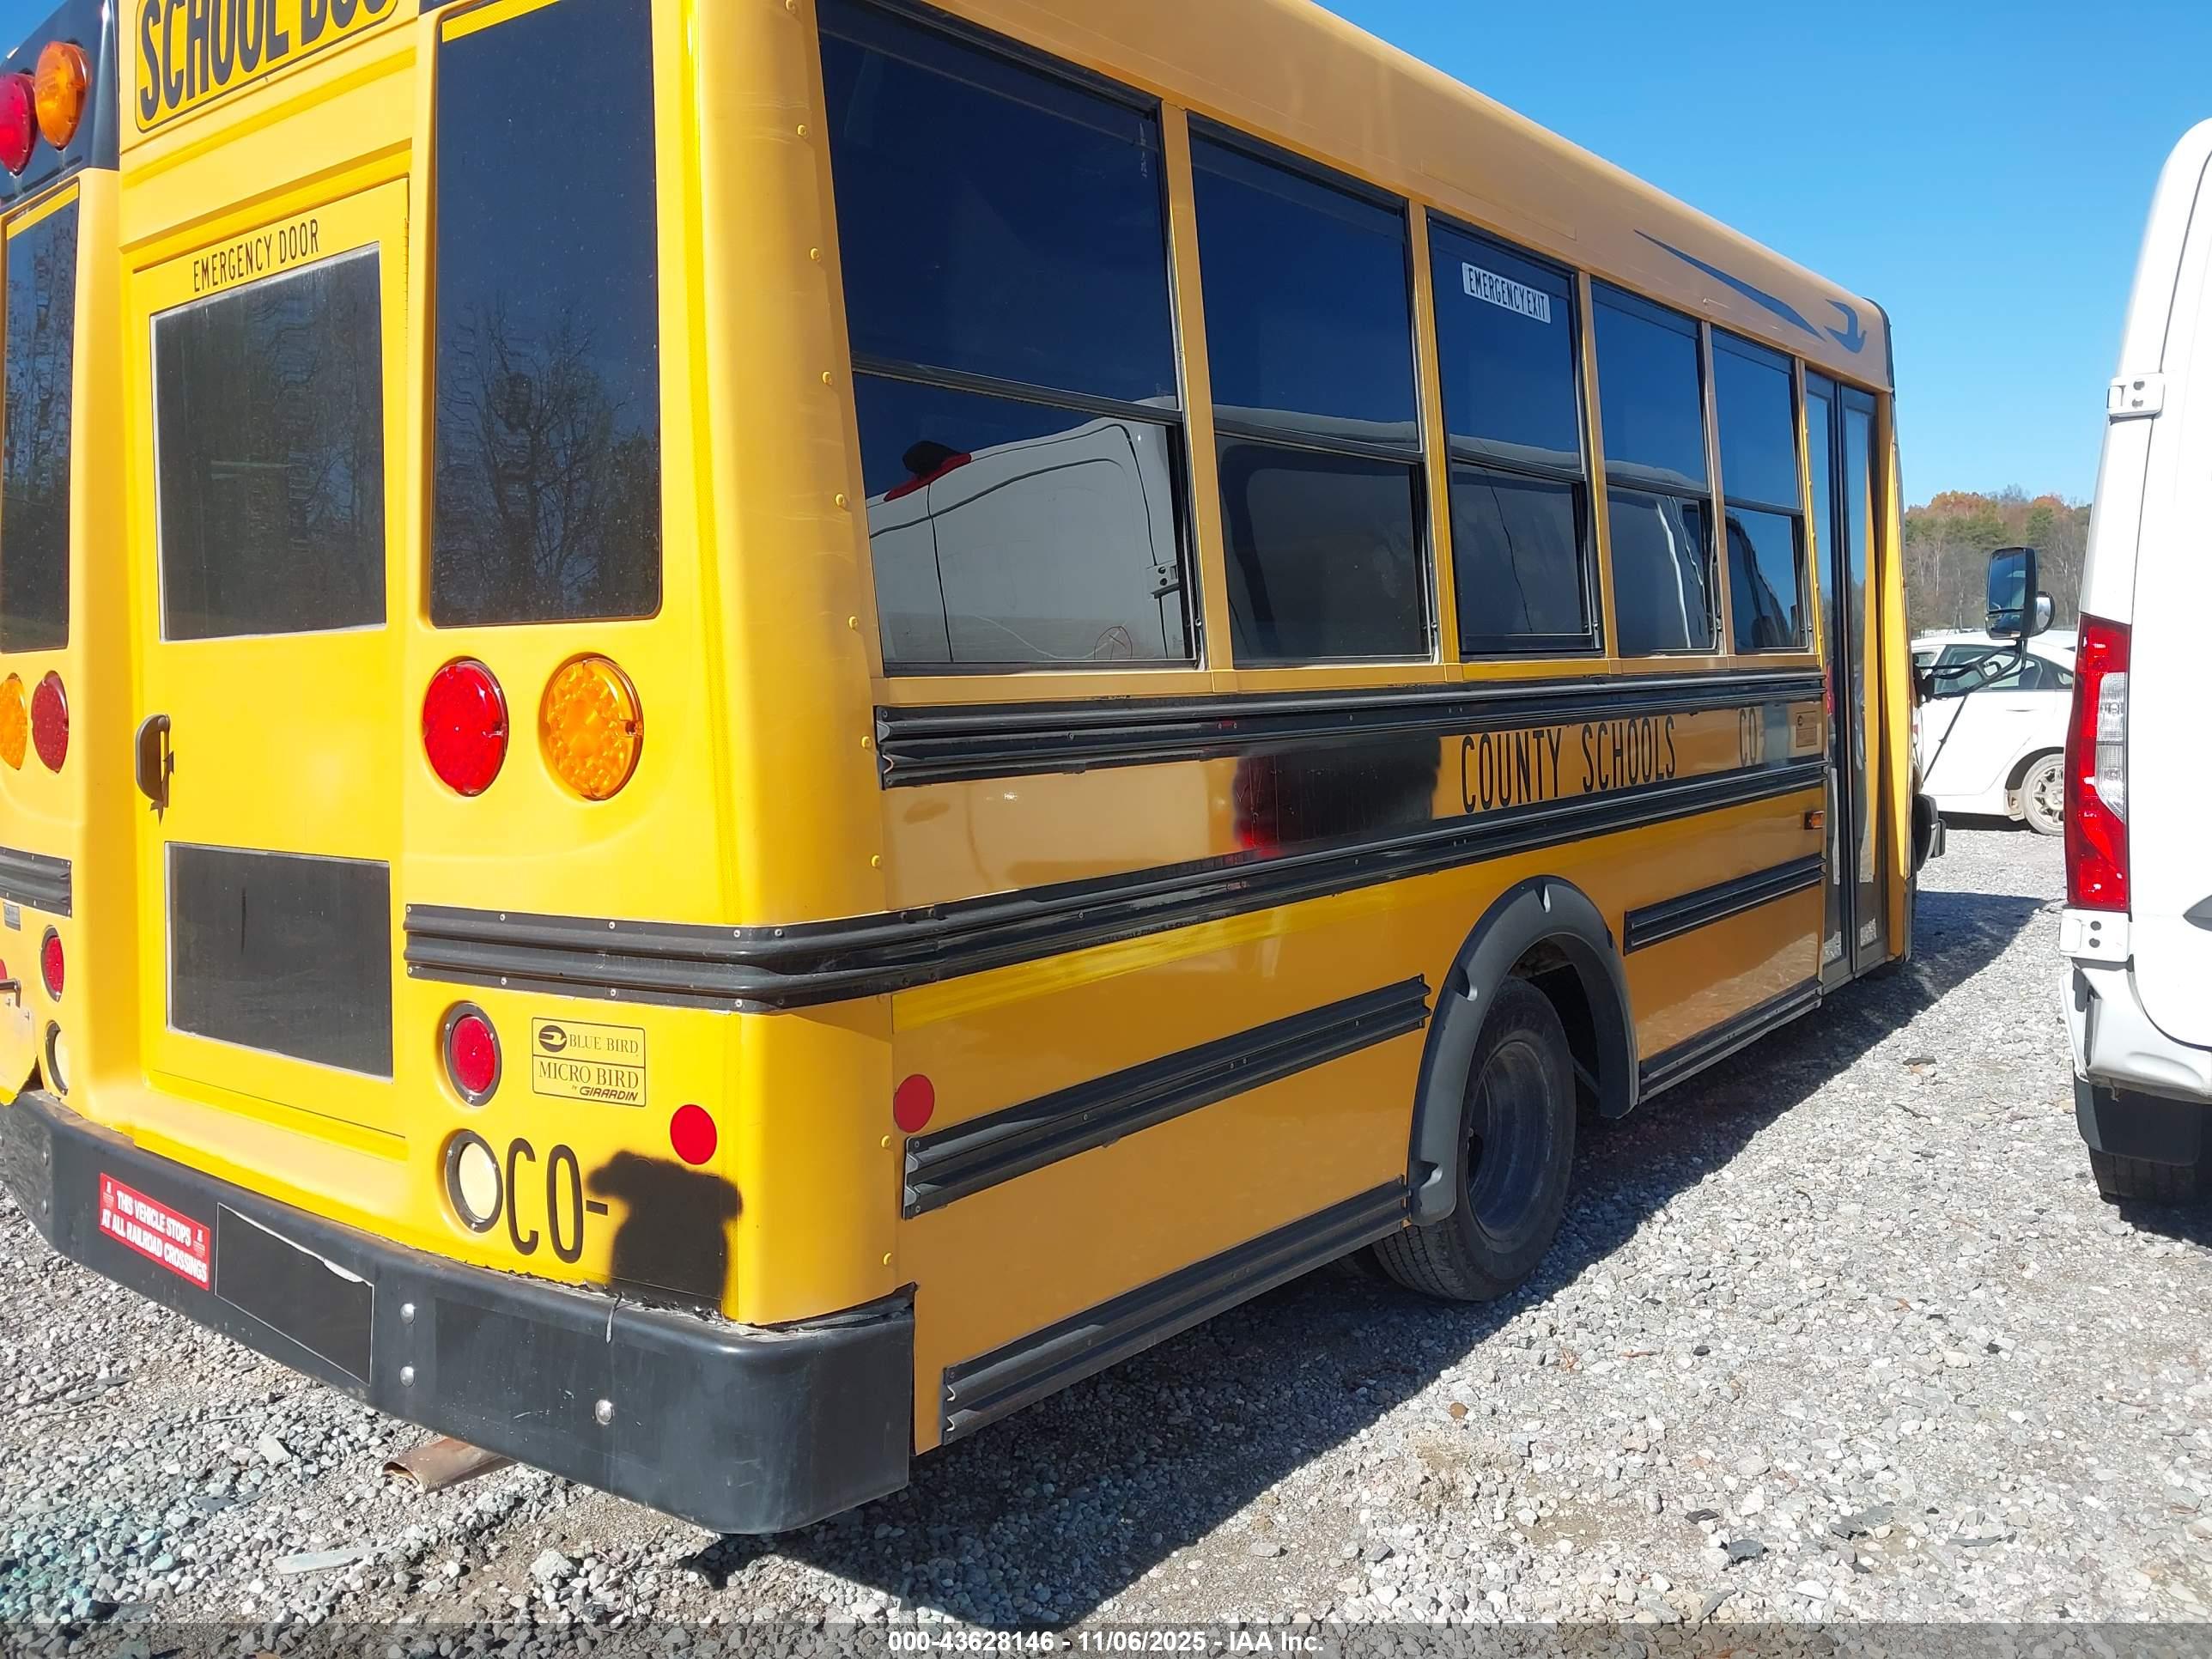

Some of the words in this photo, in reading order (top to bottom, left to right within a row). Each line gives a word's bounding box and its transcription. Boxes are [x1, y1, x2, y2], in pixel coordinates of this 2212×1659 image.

[193, 233, 272, 293] EMERGENCY
[278, 218, 319, 264] DOOR
[1468, 267, 1525, 313] EMERGENCY
[1527, 290, 1547, 320] EXIT
[1461, 727, 1562, 814] COUNTY
[1581, 714, 1675, 793] SCHOOLS
[569, 1033, 602, 1050] BLUE
[605, 1037, 639, 1054] BIRD
[538, 1060, 592, 1084] MICRO
[597, 1067, 639, 1090] BIRD
[579, 1085, 639, 1103] GIRARDIN
[101, 1208, 112, 1229] AT
[112, 1213, 126, 1238] ALL
[126, 1220, 163, 1258] RAILROAD
[163, 1242, 208, 1283] CROSSINGS
[116, 1189, 134, 1217] THIS
[134, 1200, 167, 1234] VEHICLE
[166, 1216, 191, 1247] STOPS
